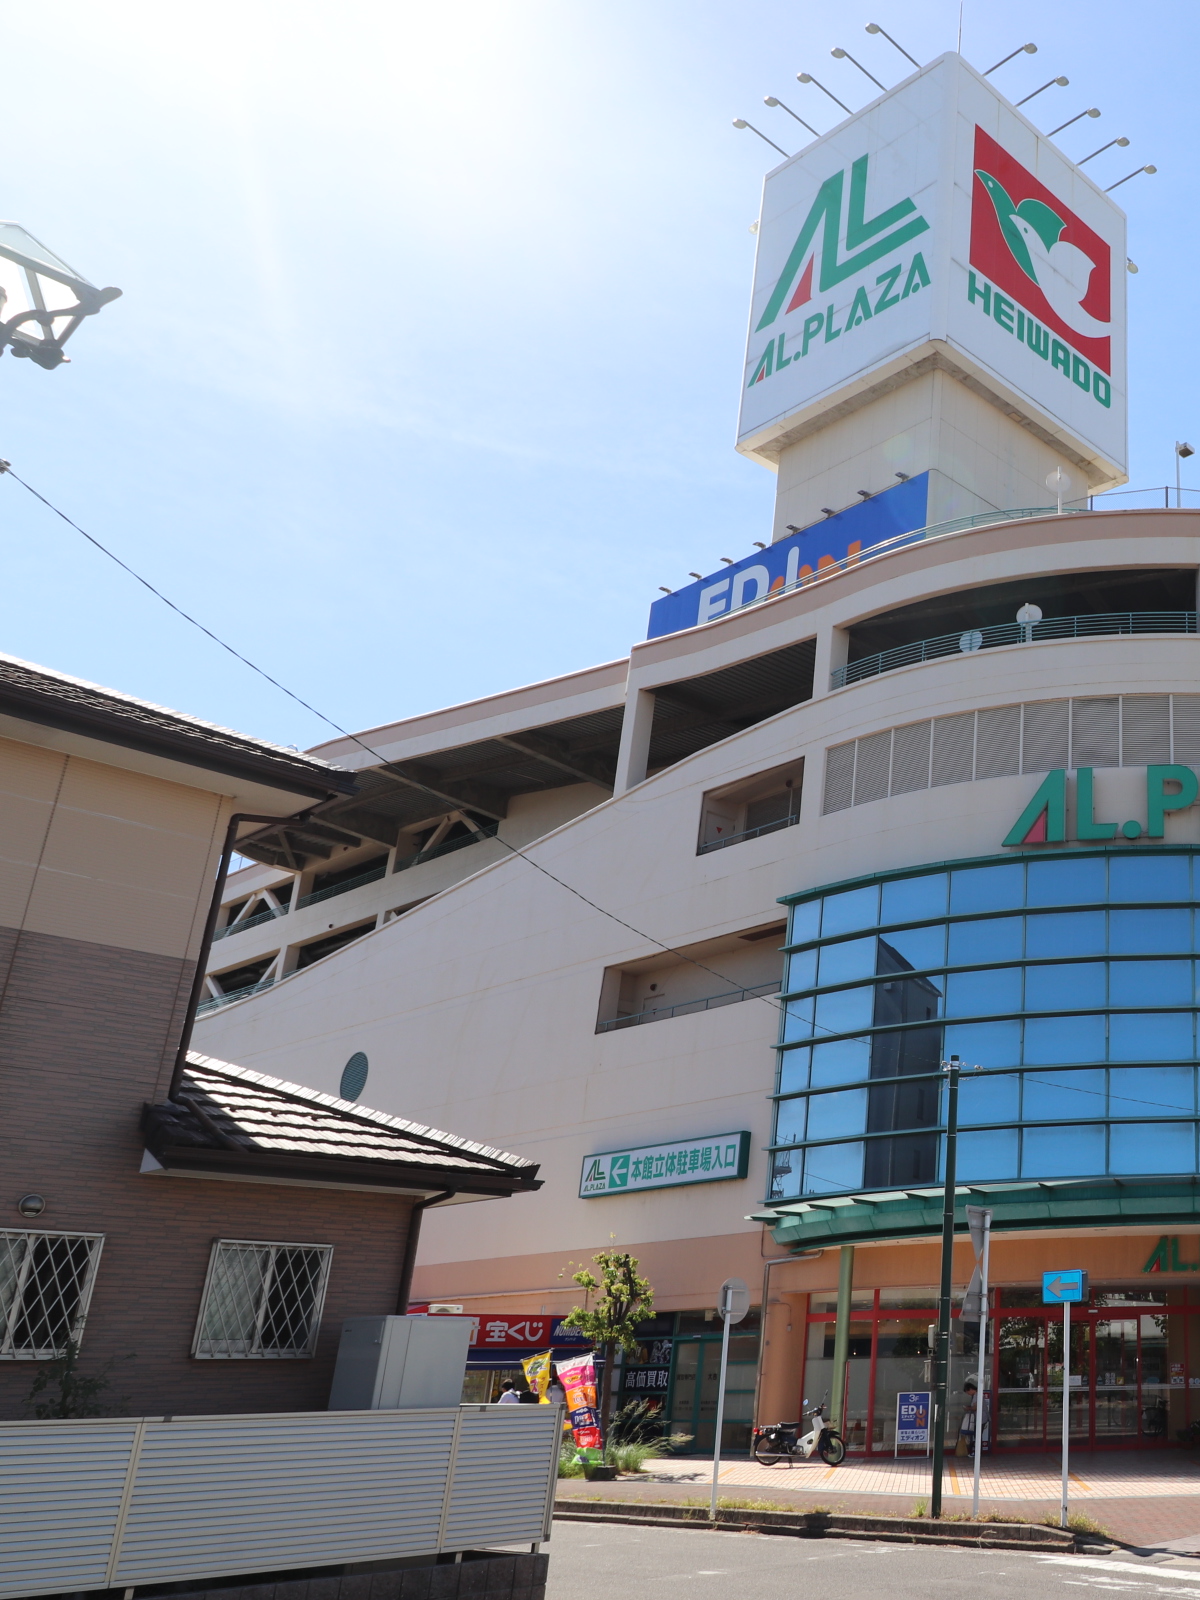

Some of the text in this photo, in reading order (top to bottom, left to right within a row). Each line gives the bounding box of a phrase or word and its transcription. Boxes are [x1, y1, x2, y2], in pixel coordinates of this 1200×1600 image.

[747, 251, 932, 388] AL.PLAZA
[967, 269, 1111, 409] HEIWADO
[631, 1144, 737, 1182] 本館立体駐車場入口
[485, 1320, 543, 1342] 宝くじ
[625, 1369, 669, 1388] 高価買取
